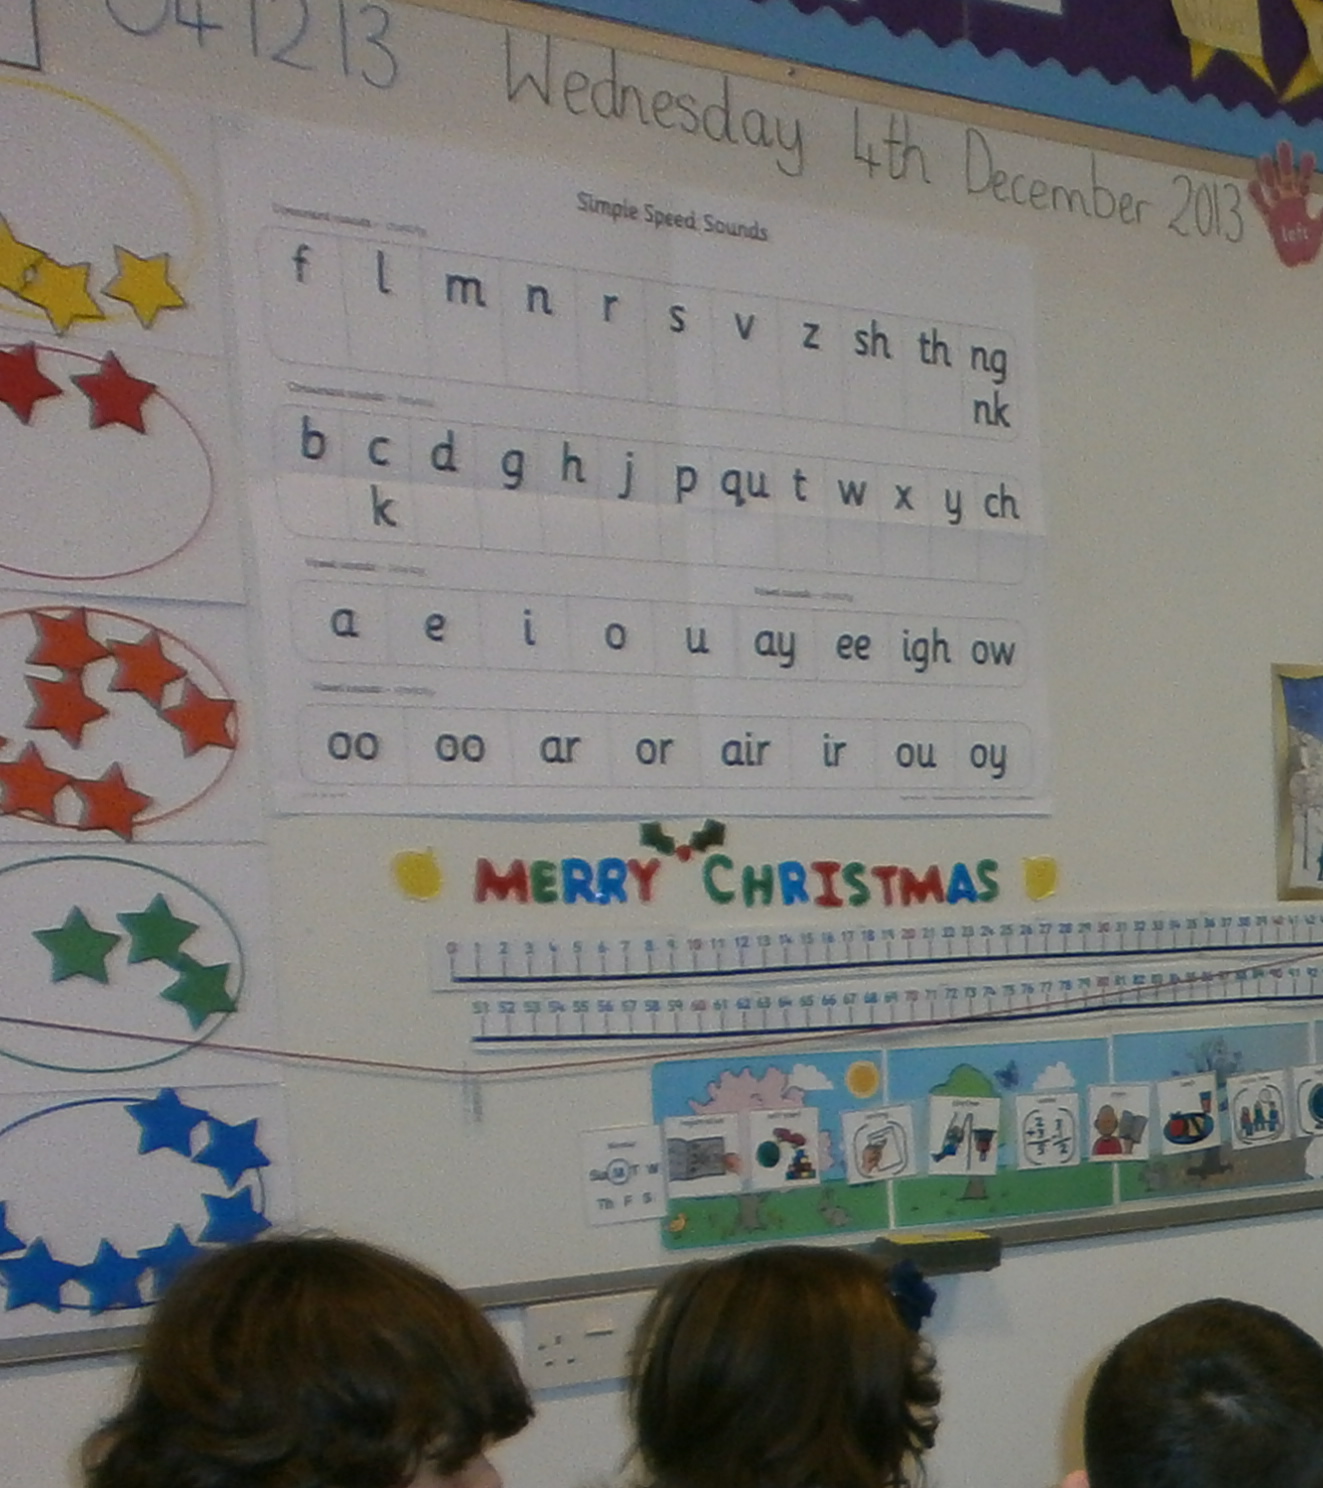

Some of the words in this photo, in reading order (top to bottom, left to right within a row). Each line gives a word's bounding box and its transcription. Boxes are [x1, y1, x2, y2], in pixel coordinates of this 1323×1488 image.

[503, 28, 804, 178] Wednesday
[851, 106, 930, 185] 4th
[964, 127, 1151, 225] December
[1168, 174, 1245, 243] 2013
[577, 191, 639, 223] Simple
[644, 203, 697, 231] Speed
[704, 214, 769, 242] Sounds
[293, 244, 310, 282] f
[377, 251, 390, 294] l
[447, 275, 486, 307] m
[528, 286, 553, 315] n
[604, 296, 618, 321] r
[670, 306, 685, 333] s
[735, 314, 754, 340] v
[803, 323, 819, 349] z
[855, 320, 891, 359] sh
[919, 329, 951, 367] th
[971, 347, 1007, 385] ng
[974, 391, 1010, 427] nk
[302, 416, 326, 460] b
[369, 437, 389, 466] c
[432, 431, 458, 472] d
[502, 450, 524, 490] g
[563, 442, 586, 483] h
[618, 452, 633, 500] j
[677, 466, 697, 503] p
[721, 470, 769, 507] qu
[793, 469, 806, 501] t
[838, 481, 866, 506] w
[896, 486, 913, 510] x
[946, 490, 962, 525] y
[984, 483, 1019, 519] ch
[372, 485, 397, 527] k
[332, 609, 359, 638] a
[426, 614, 446, 642] e
[524, 609, 536, 646] i
[605, 623, 626, 650] o
[687, 628, 709, 654] u
[755, 631, 796, 669] ay
[837, 635, 871, 660] ee
[903, 628, 951, 673] igh
[972, 641, 1015, 665] ow
[328, 732, 379, 760] oo
[436, 734, 485, 762] oo
[541, 736, 581, 764] ar
[636, 739, 673, 765] or
[722, 732, 770, 766] air
[824, 734, 847, 767] ir
[896, 743, 937, 768] ou
[970, 744, 1006, 779] oy
[475, 856, 661, 903] MERRY
[702, 852, 999, 907] CHRISTMAS
